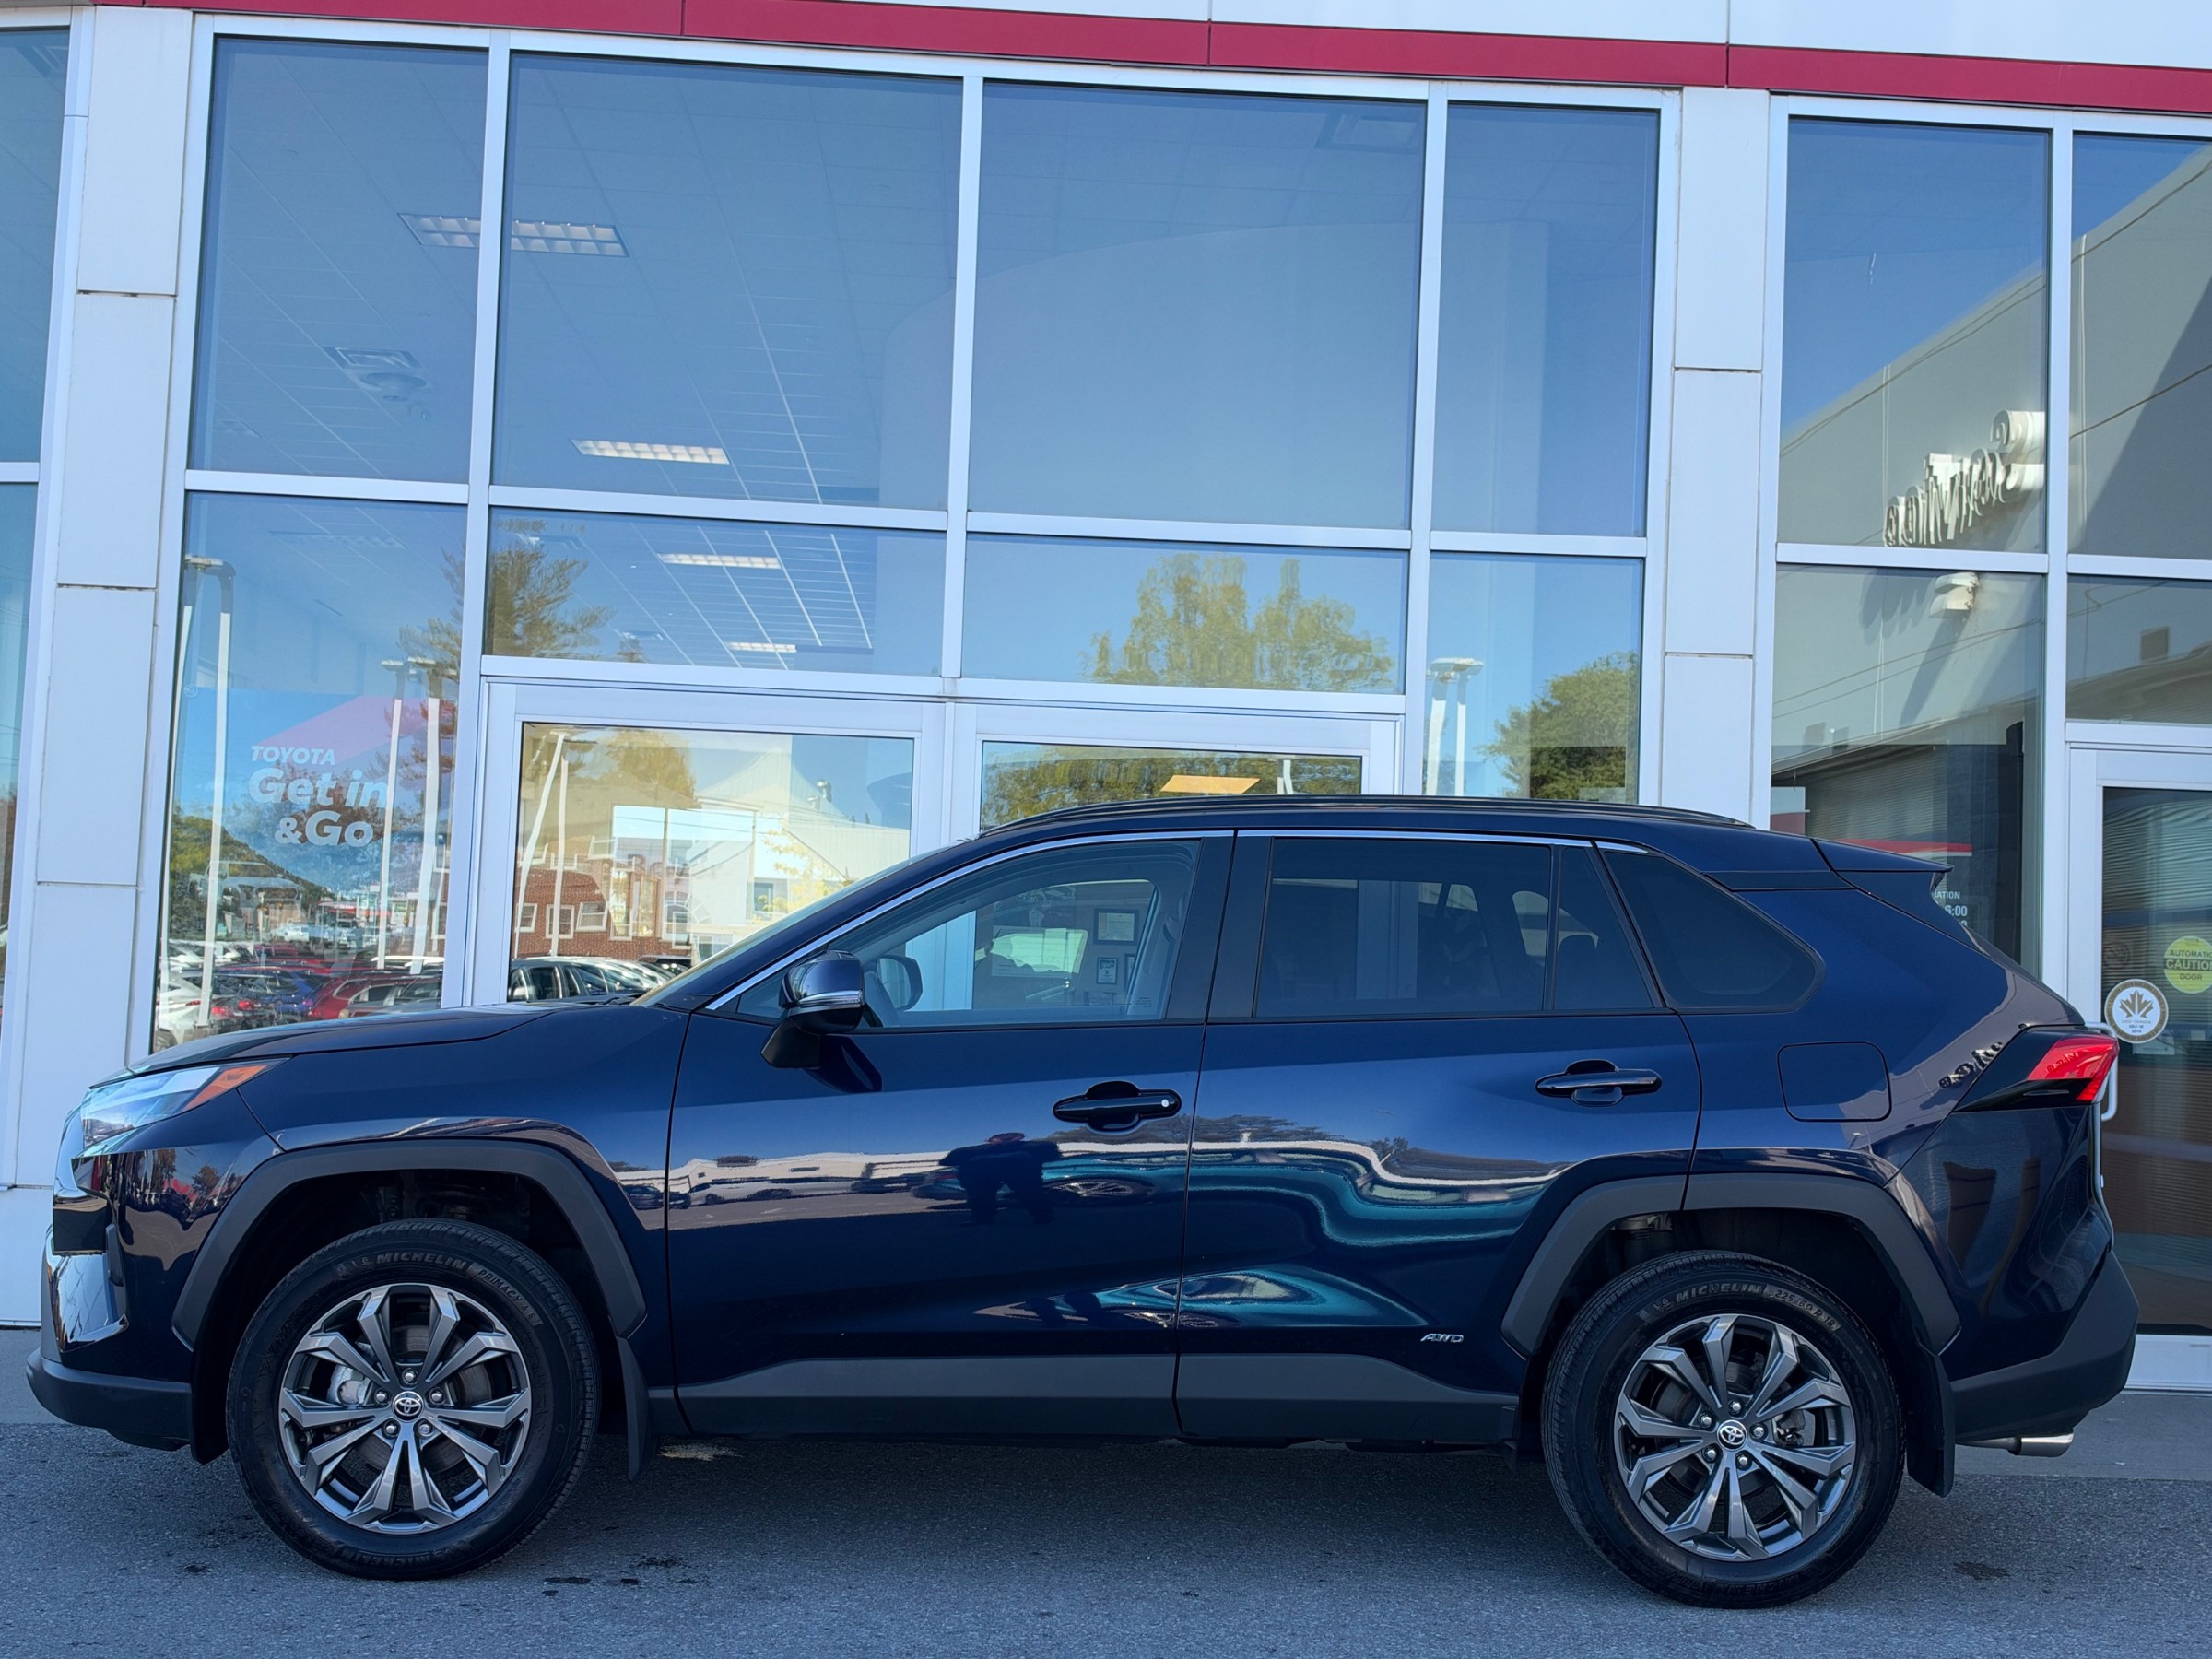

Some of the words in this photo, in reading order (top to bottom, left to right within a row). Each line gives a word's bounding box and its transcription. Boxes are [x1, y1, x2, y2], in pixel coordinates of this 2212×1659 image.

[251, 745, 335, 766] TOYOTA
[249, 767, 338, 806] Get
[345, 769, 389, 808] in
[2179, 972, 2203, 982] DOOR
[376, 1252, 467, 1270] MICHELIN
[478, 1268, 523, 1301] PRIMACY
[1676, 1282, 1766, 1303] MICHELIN
[1420, 1333, 1465, 1343] AWD
